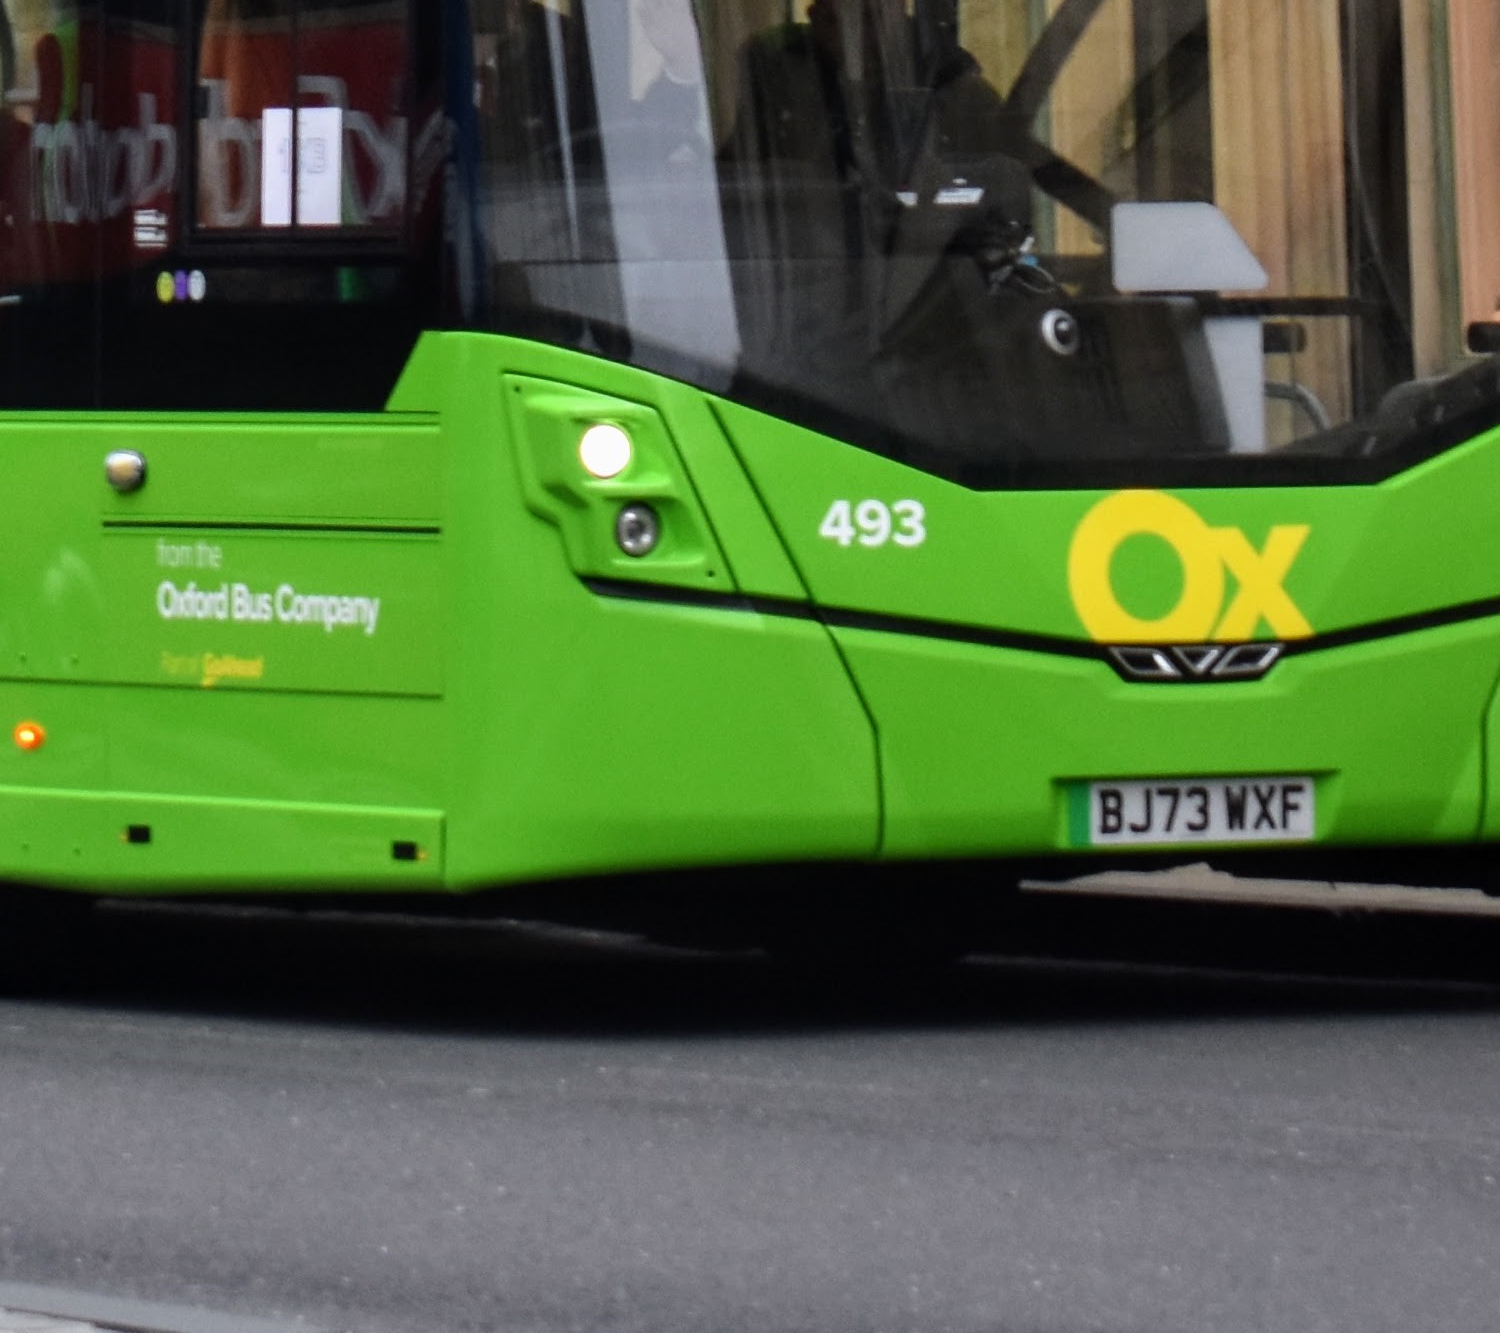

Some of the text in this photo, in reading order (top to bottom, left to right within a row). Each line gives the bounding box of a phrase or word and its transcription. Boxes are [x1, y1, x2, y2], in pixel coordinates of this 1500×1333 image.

[818, 499, 927, 547] 493
[1067, 489, 1315, 645] Ox
[156, 580, 381, 636] Oxford Bus Company
[1099, 785, 1307, 834] BJ73 WXF
